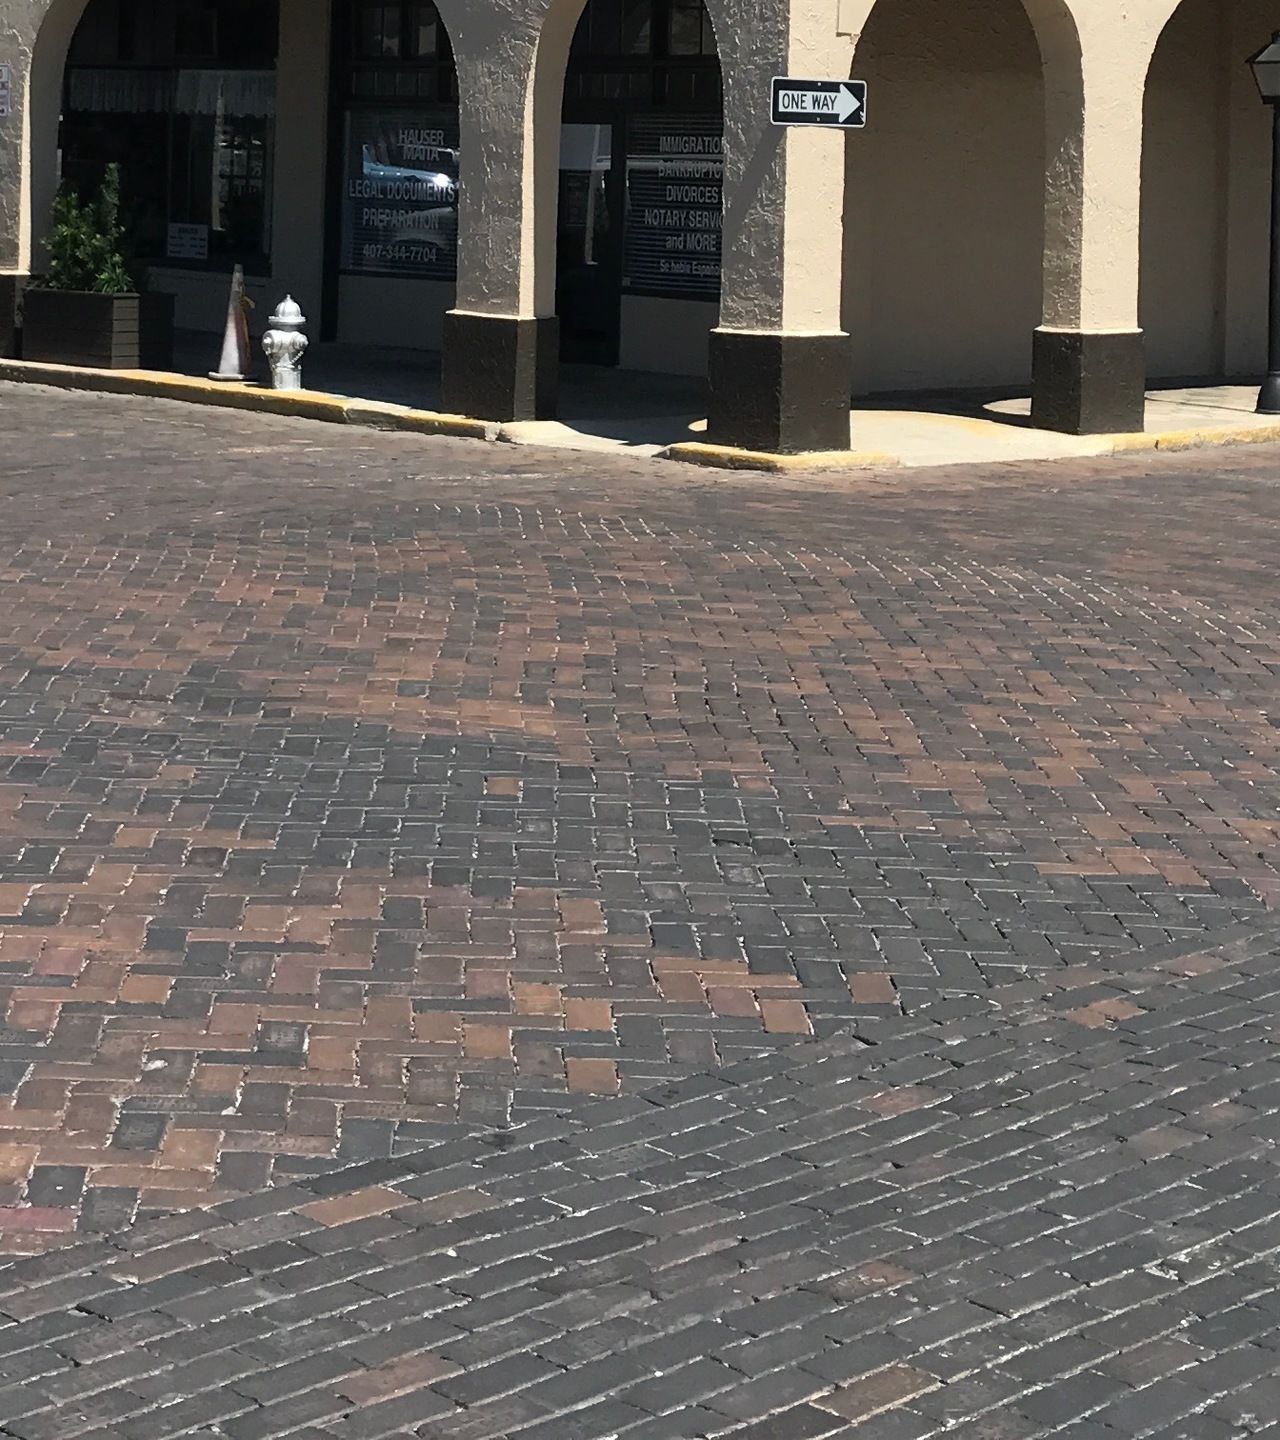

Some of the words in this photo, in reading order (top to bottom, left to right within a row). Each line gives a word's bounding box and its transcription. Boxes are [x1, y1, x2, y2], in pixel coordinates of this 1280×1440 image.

[782, 93, 807, 110] ONE
[812, 94, 837, 111] WAY
[399, 129, 444, 146] HAUSER
[660, 136, 723, 153] IMMIGRATIO
[658, 161, 721, 178] BANKRUPTC
[349, 179, 384, 198] LEGAL
[387, 181, 455, 202] DOCUMENTS
[666, 185, 719, 202] DIVORCES
[362, 207, 439, 229] PREPARATION
[645, 209, 686, 226] NOTARY
[689, 211, 723, 228] SERVIC
[665, 233, 684, 250] and
[687, 233, 717, 251] MORE
[363, 243, 437, 262] 407-344-7704
